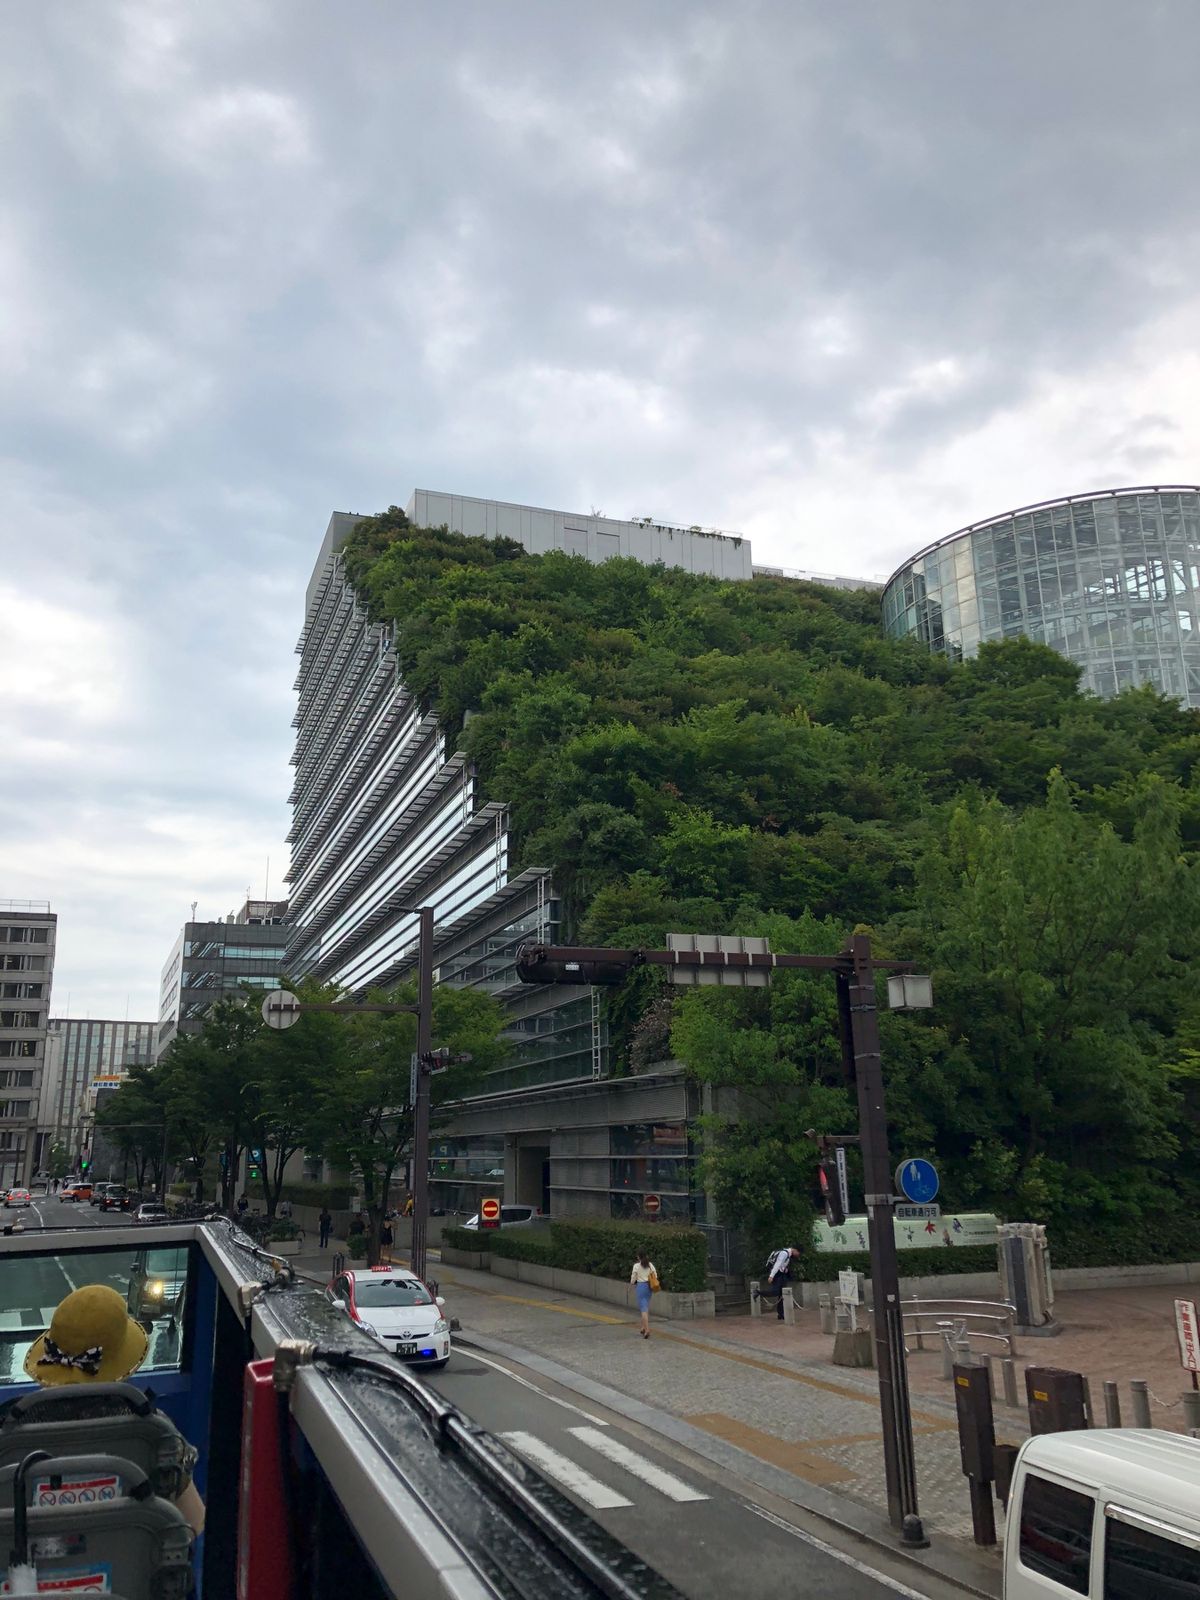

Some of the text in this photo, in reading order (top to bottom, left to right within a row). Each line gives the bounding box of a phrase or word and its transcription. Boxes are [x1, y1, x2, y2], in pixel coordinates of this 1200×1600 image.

[898, 1207, 937, 1218] 自転車通行可
